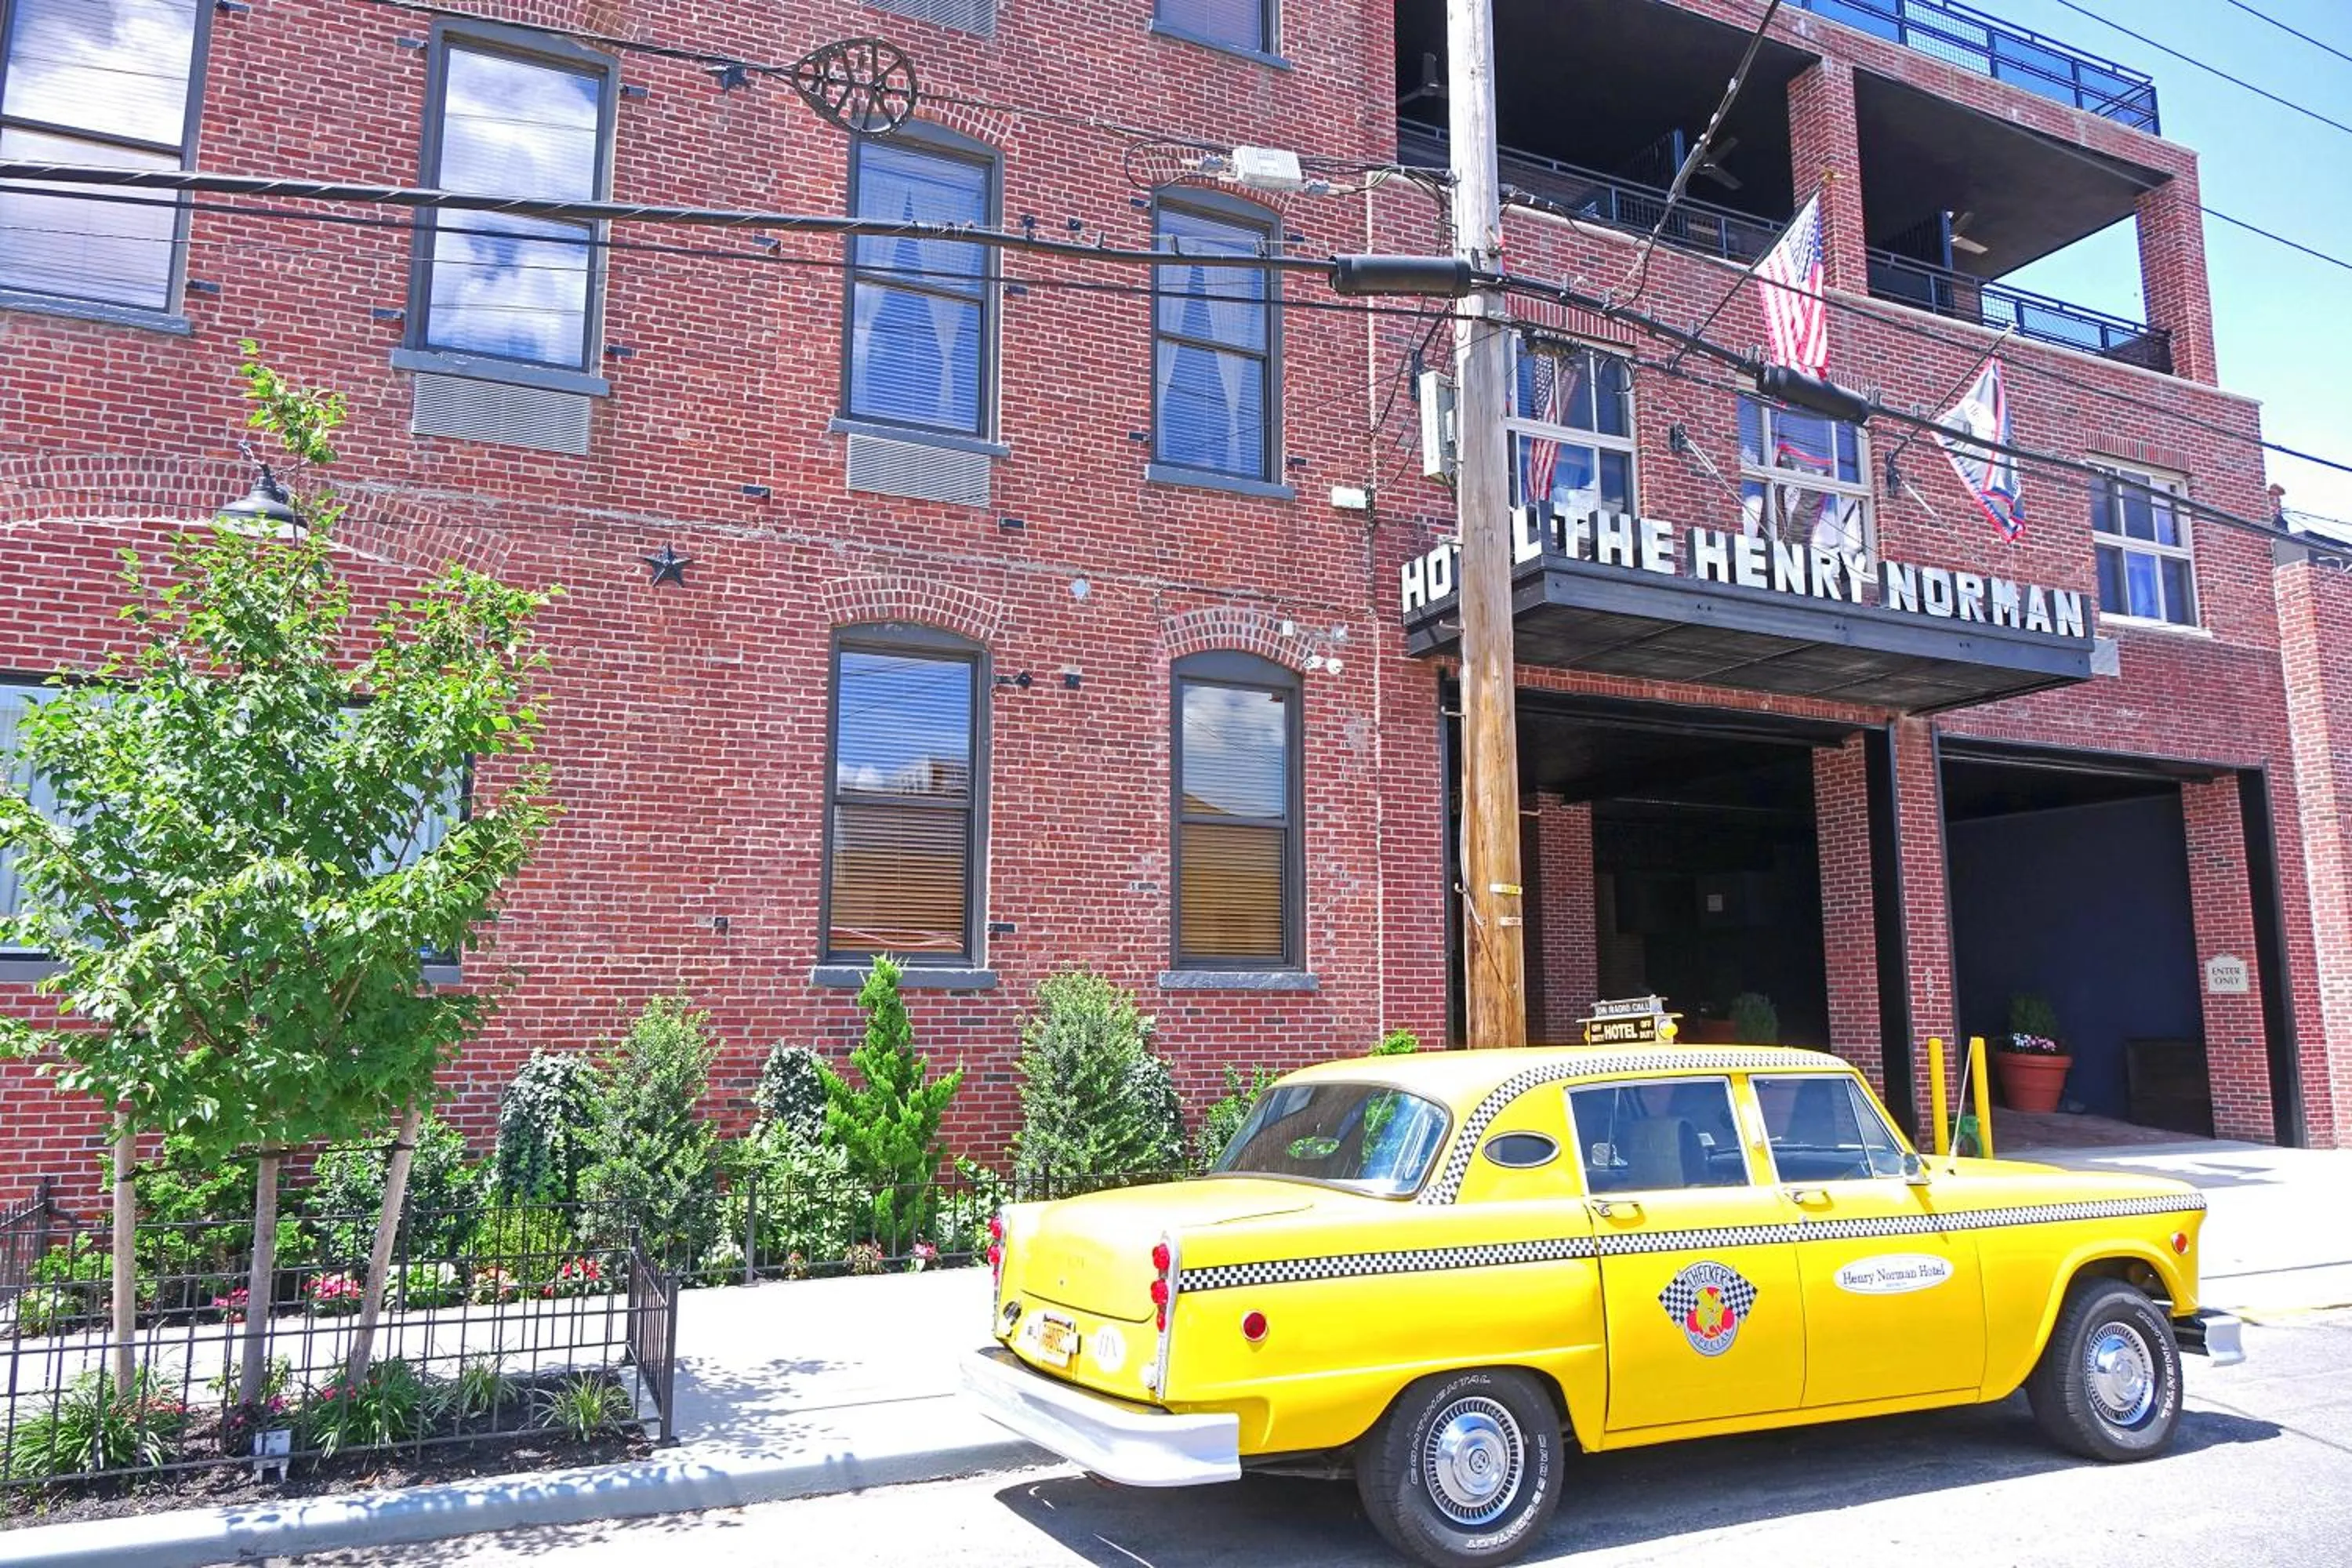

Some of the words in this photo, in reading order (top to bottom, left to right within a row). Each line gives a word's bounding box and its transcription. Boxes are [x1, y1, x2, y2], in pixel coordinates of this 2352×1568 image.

[1401, 506, 1542, 614] HOL
[1553, 502, 1675, 574] THE
[1693, 527, 1867, 604] HENRY
[1884, 560, 2085, 638] NORMAN
[1632, 1001, 1650, 1012] CALL
[1603, 1023, 1638, 1040] HOTEL
[1639, 1020, 1652, 1029] OFF
[1639, 1030, 1655, 1039] DUTY
[1685, 1264, 1728, 1288] CHECKER
[1842, 1271, 1874, 1285] Henry
[1876, 1267, 1917, 1281] Norman
[1918, 1263, 1945, 1277] Hotel
